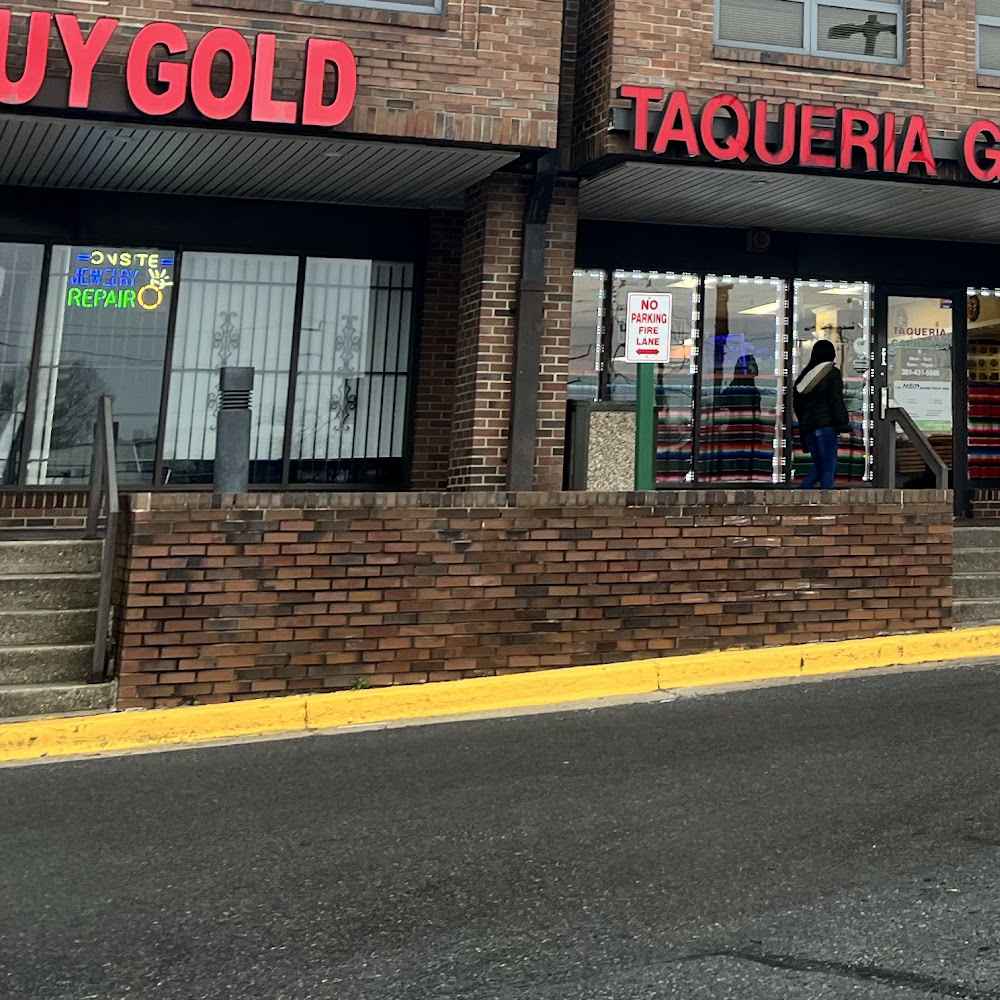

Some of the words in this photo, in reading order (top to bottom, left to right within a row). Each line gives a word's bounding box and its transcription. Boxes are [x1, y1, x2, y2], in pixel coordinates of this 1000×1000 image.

[0, 8, 120, 108] UY
[126, 22, 358, 127] GOLD
[621, 85, 939, 178] TAQUERIA
[67, 287, 137, 308] REPAIR
[641, 300, 658, 310] NO
[631, 312, 667, 324] PARKING
[638, 326, 659, 335] FIRE
[893, 326, 946, 336] TAQUERIA
[636, 338, 660, 346] LANE
